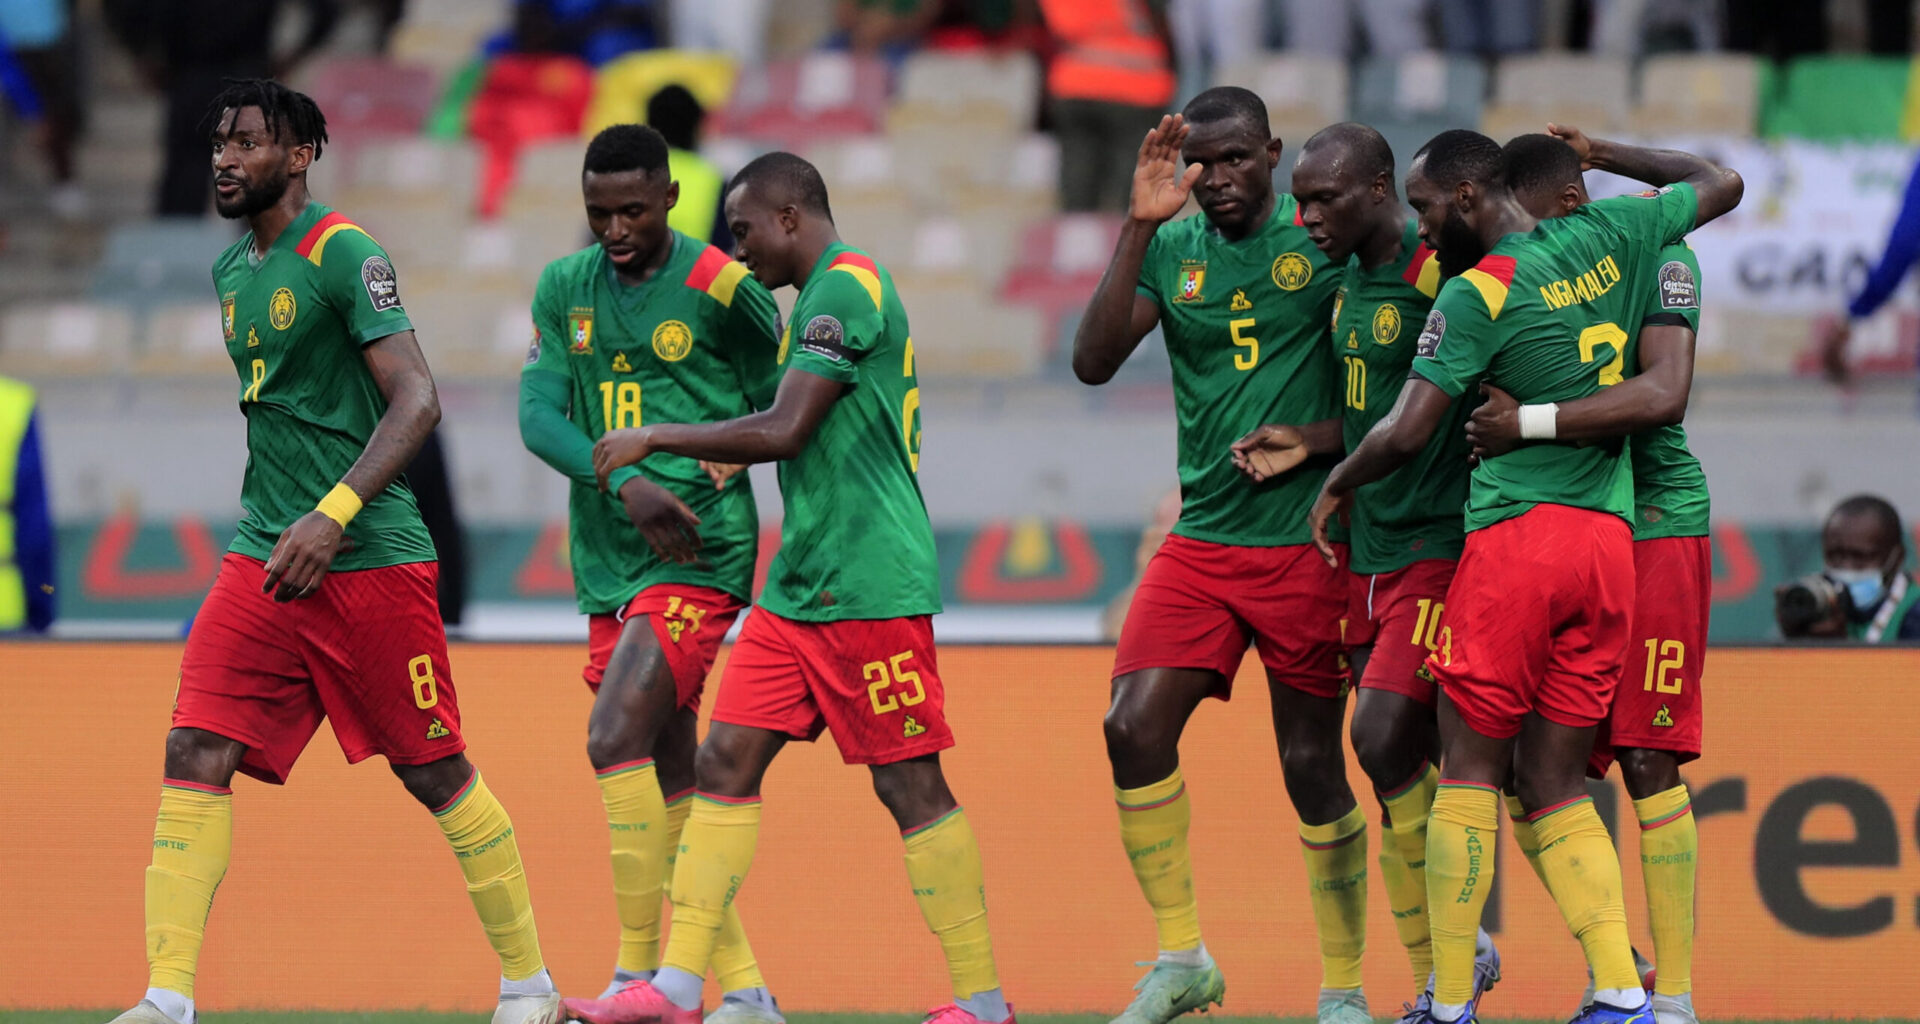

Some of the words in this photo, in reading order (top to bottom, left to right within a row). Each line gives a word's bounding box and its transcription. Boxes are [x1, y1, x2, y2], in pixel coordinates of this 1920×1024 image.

[1668, 297, 1691, 305] CAF
[1230, 318, 1259, 371] 5
[1578, 322, 1628, 386] 3
[600, 381, 642, 432] 18
[1344, 356, 1366, 411] 10
[1410, 599, 1446, 651] 10
[408, 653, 438, 710] 8
[862, 649, 926, 715] 25
[1643, 637, 1685, 695] 12
[1456, 826, 1483, 904] CAMEROUN
